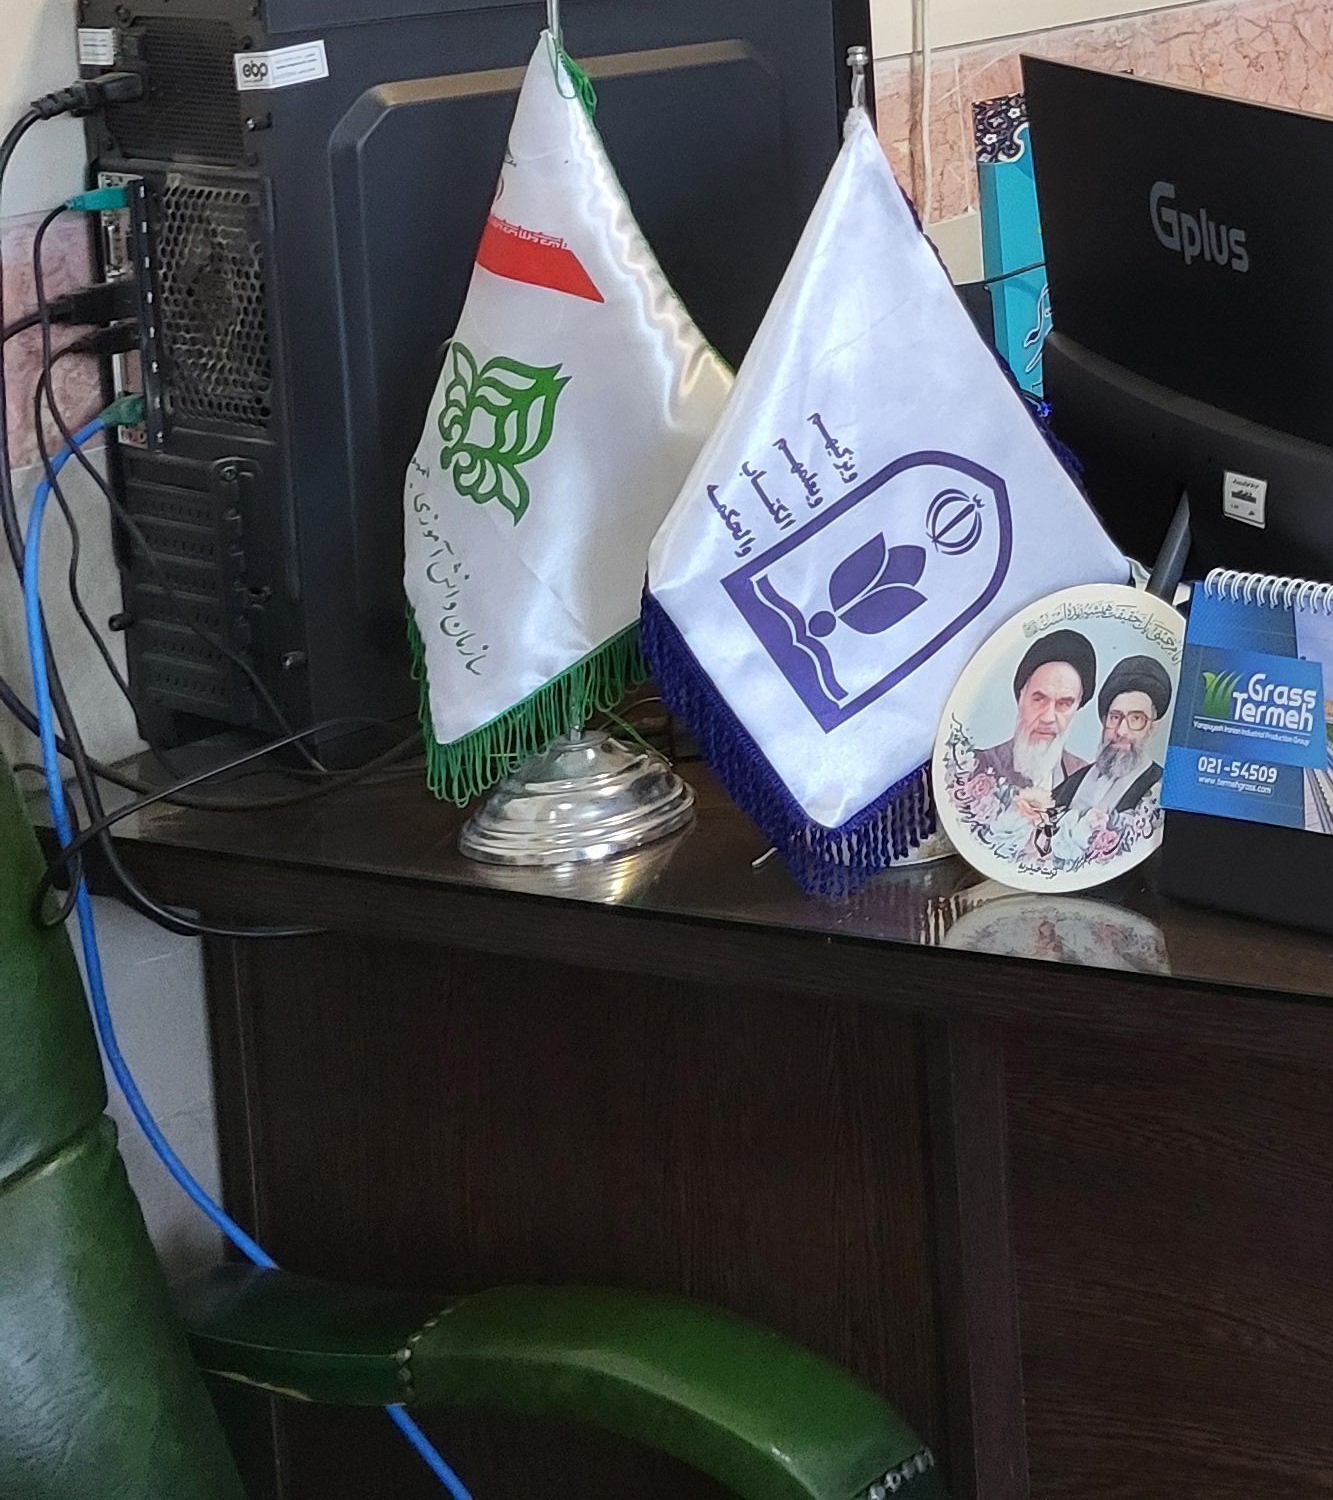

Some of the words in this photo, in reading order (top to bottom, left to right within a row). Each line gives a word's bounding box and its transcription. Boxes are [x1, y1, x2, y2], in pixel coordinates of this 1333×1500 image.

[1149, 179, 1250, 273] Gplus
[413, 492, 455, 558] آموزی
[425, 561, 471, 612] دانش
[438, 614, 490, 677] سازمان
[1232, 691, 1314, 733] Termeh
[1247, 672, 1318, 710] Grass
[1264, 731, 1294, 744] Production
[1293, 735, 1311, 748] Group
[1196, 756, 1279, 784] 021-54509
[1197, 775, 1272, 795] www.termehgrass.com
